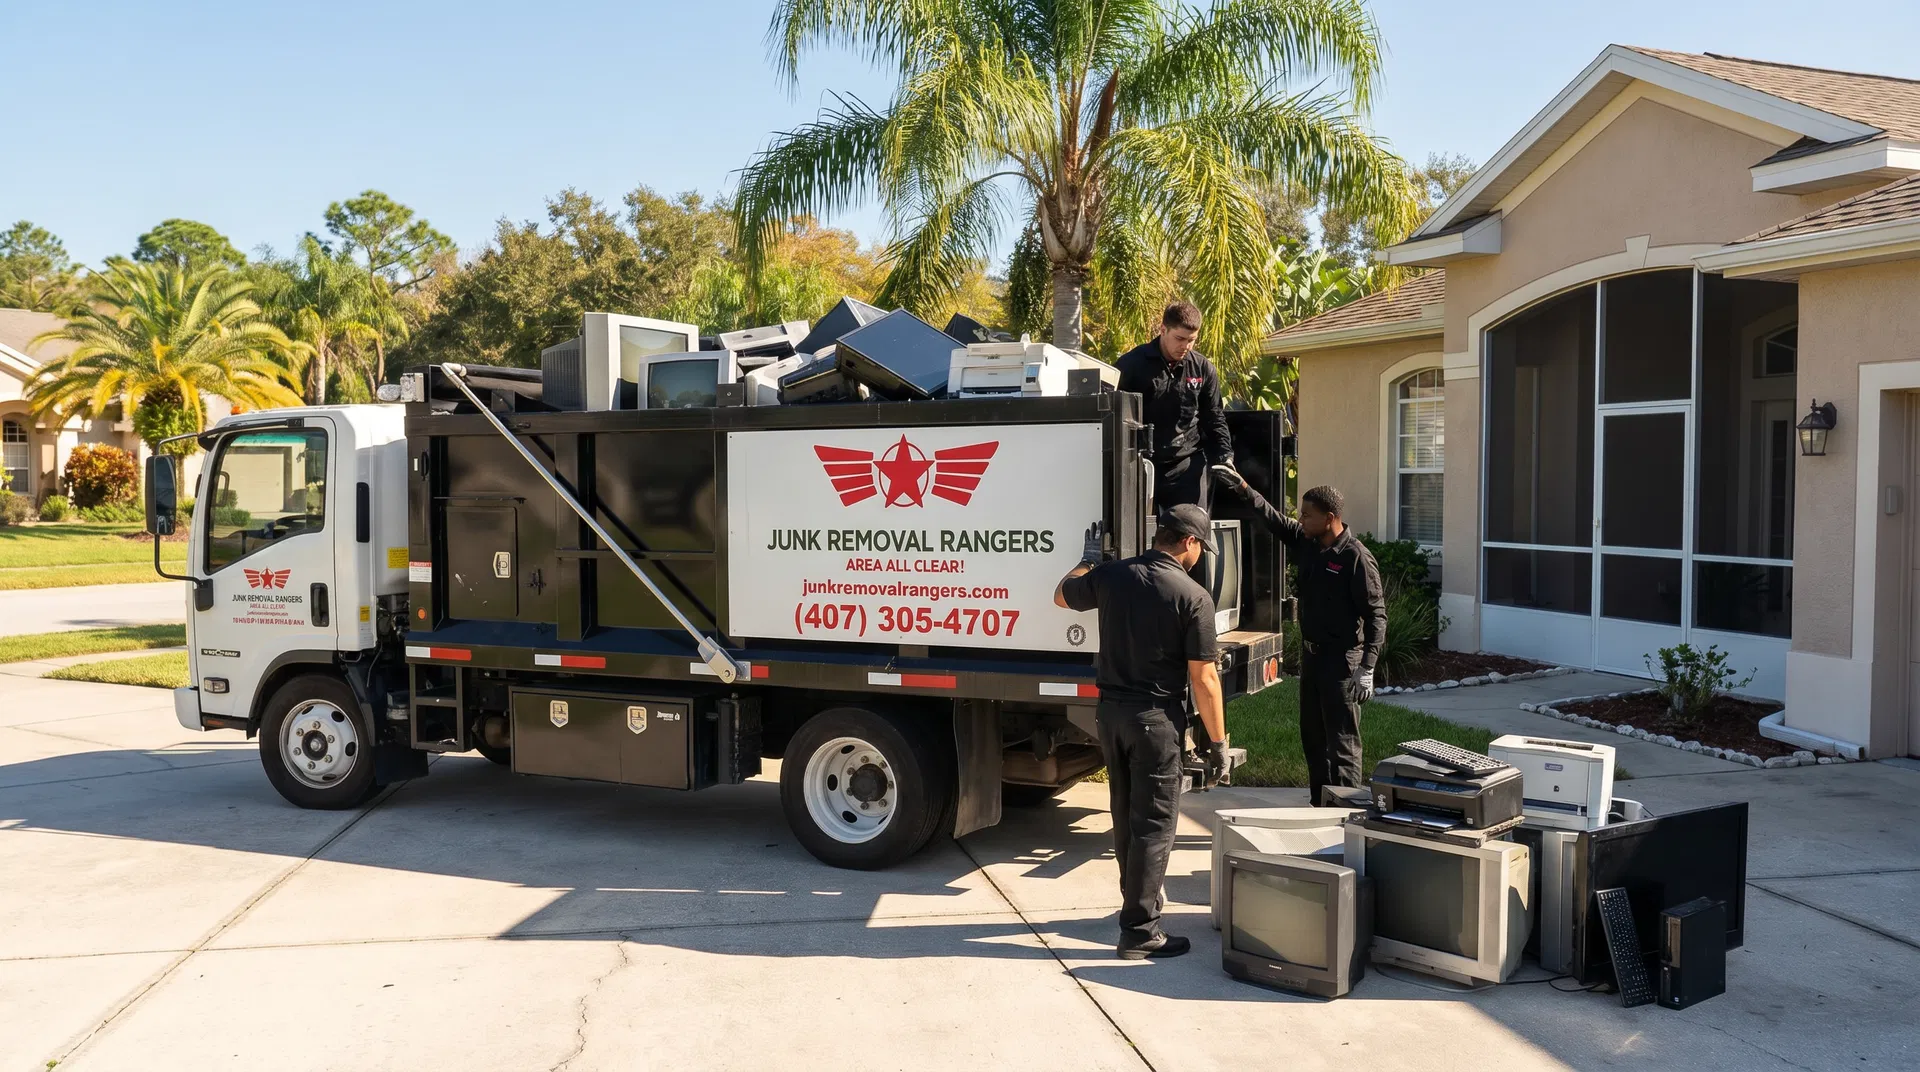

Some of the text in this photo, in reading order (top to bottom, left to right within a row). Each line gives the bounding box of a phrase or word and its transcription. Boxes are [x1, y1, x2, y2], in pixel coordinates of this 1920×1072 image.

[767, 529, 1055, 553] JUNK REMOVAL RANGERS
[846, 557, 965, 573] AREA ALL CLEAR!
[276, 595, 303, 603] RANGERS
[802, 579, 1009, 601] junkremovalrangers.com
[794, 602, 1021, 637] (407) 305-4707
